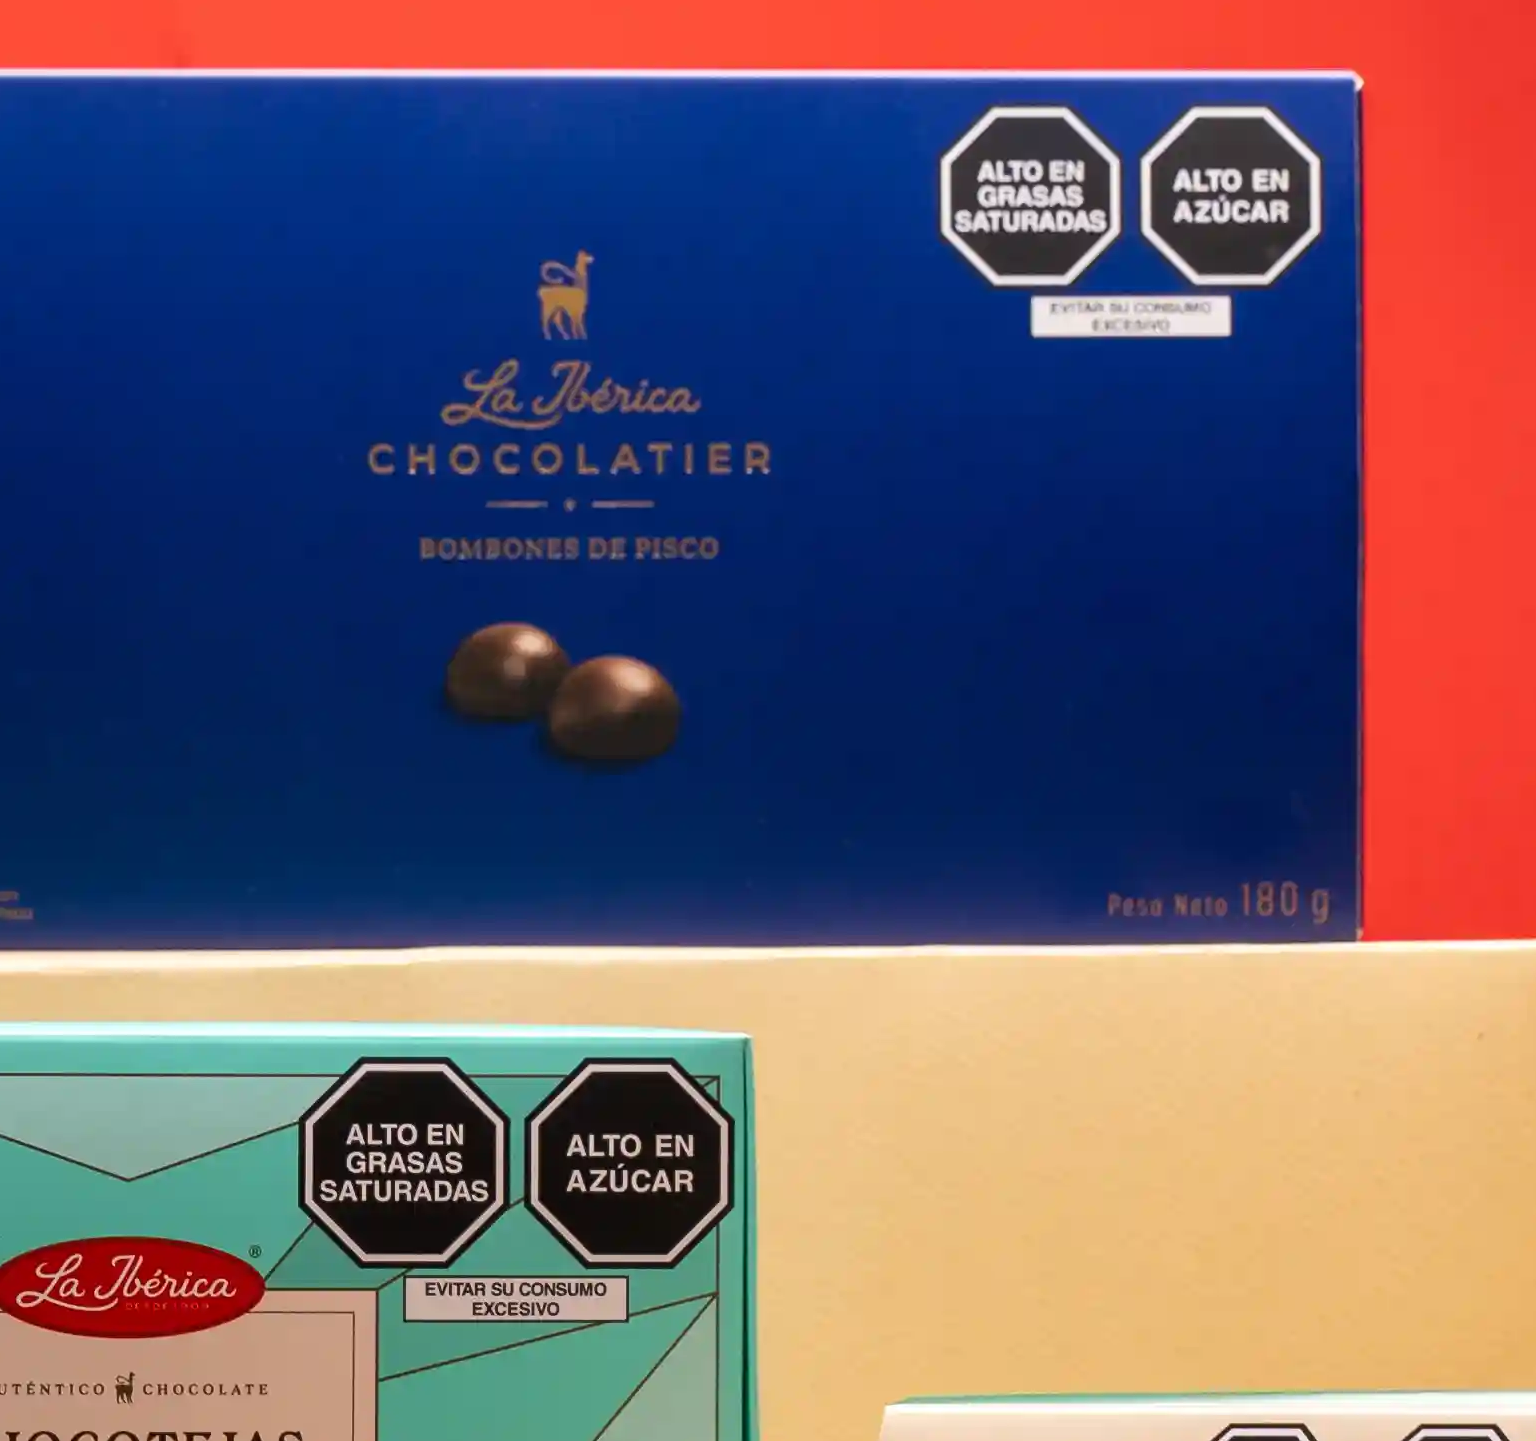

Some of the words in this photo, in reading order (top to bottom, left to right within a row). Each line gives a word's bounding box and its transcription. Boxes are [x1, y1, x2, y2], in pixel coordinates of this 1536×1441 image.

[977, 161, 1043, 183] ALTO
[1049, 161, 1085, 183] EN
[1173, 169, 1242, 193] ALTO
[1252, 169, 1290, 193] EN
[977, 186, 1084, 208] GRASAS
[1173, 195, 1290, 224] AZÚCAR
[955, 210, 1107, 233] SATURADAS
[441, 359, 561, 430] La
[532, 360, 701, 415] Ibérica
[368, 443, 771, 475] CHOCOLATIER
[419, 537, 579, 561] BOMBONES
[589, 537, 627, 561] DE
[635, 537, 720, 561] PISCO
[1108, 892, 1161, 916] Peso
[1241, 880, 1298, 917] 180
[1312, 888, 1330, 924] g
[346, 1123, 417, 1145] ALTO
[427, 1123, 464, 1145] EN
[566, 1134, 642, 1158] ALTO
[655, 1134, 695, 1157] EN
[346, 1151, 463, 1174] GRASAS
[566, 1163, 695, 1194] AZÚCAR
[319, 1179, 489, 1202] SATURADAS
[15, 1253, 119, 1311] La
[94, 1254, 237, 1300] Ibérica
[424, 1282, 488, 1297] EVITAR
[491, 1282, 516, 1297] SU
[518, 1282, 607, 1297] CONSUMO
[472, 1302, 560, 1317] EXCESIVO
[143, 1383, 269, 1396] CHOCOLATE
